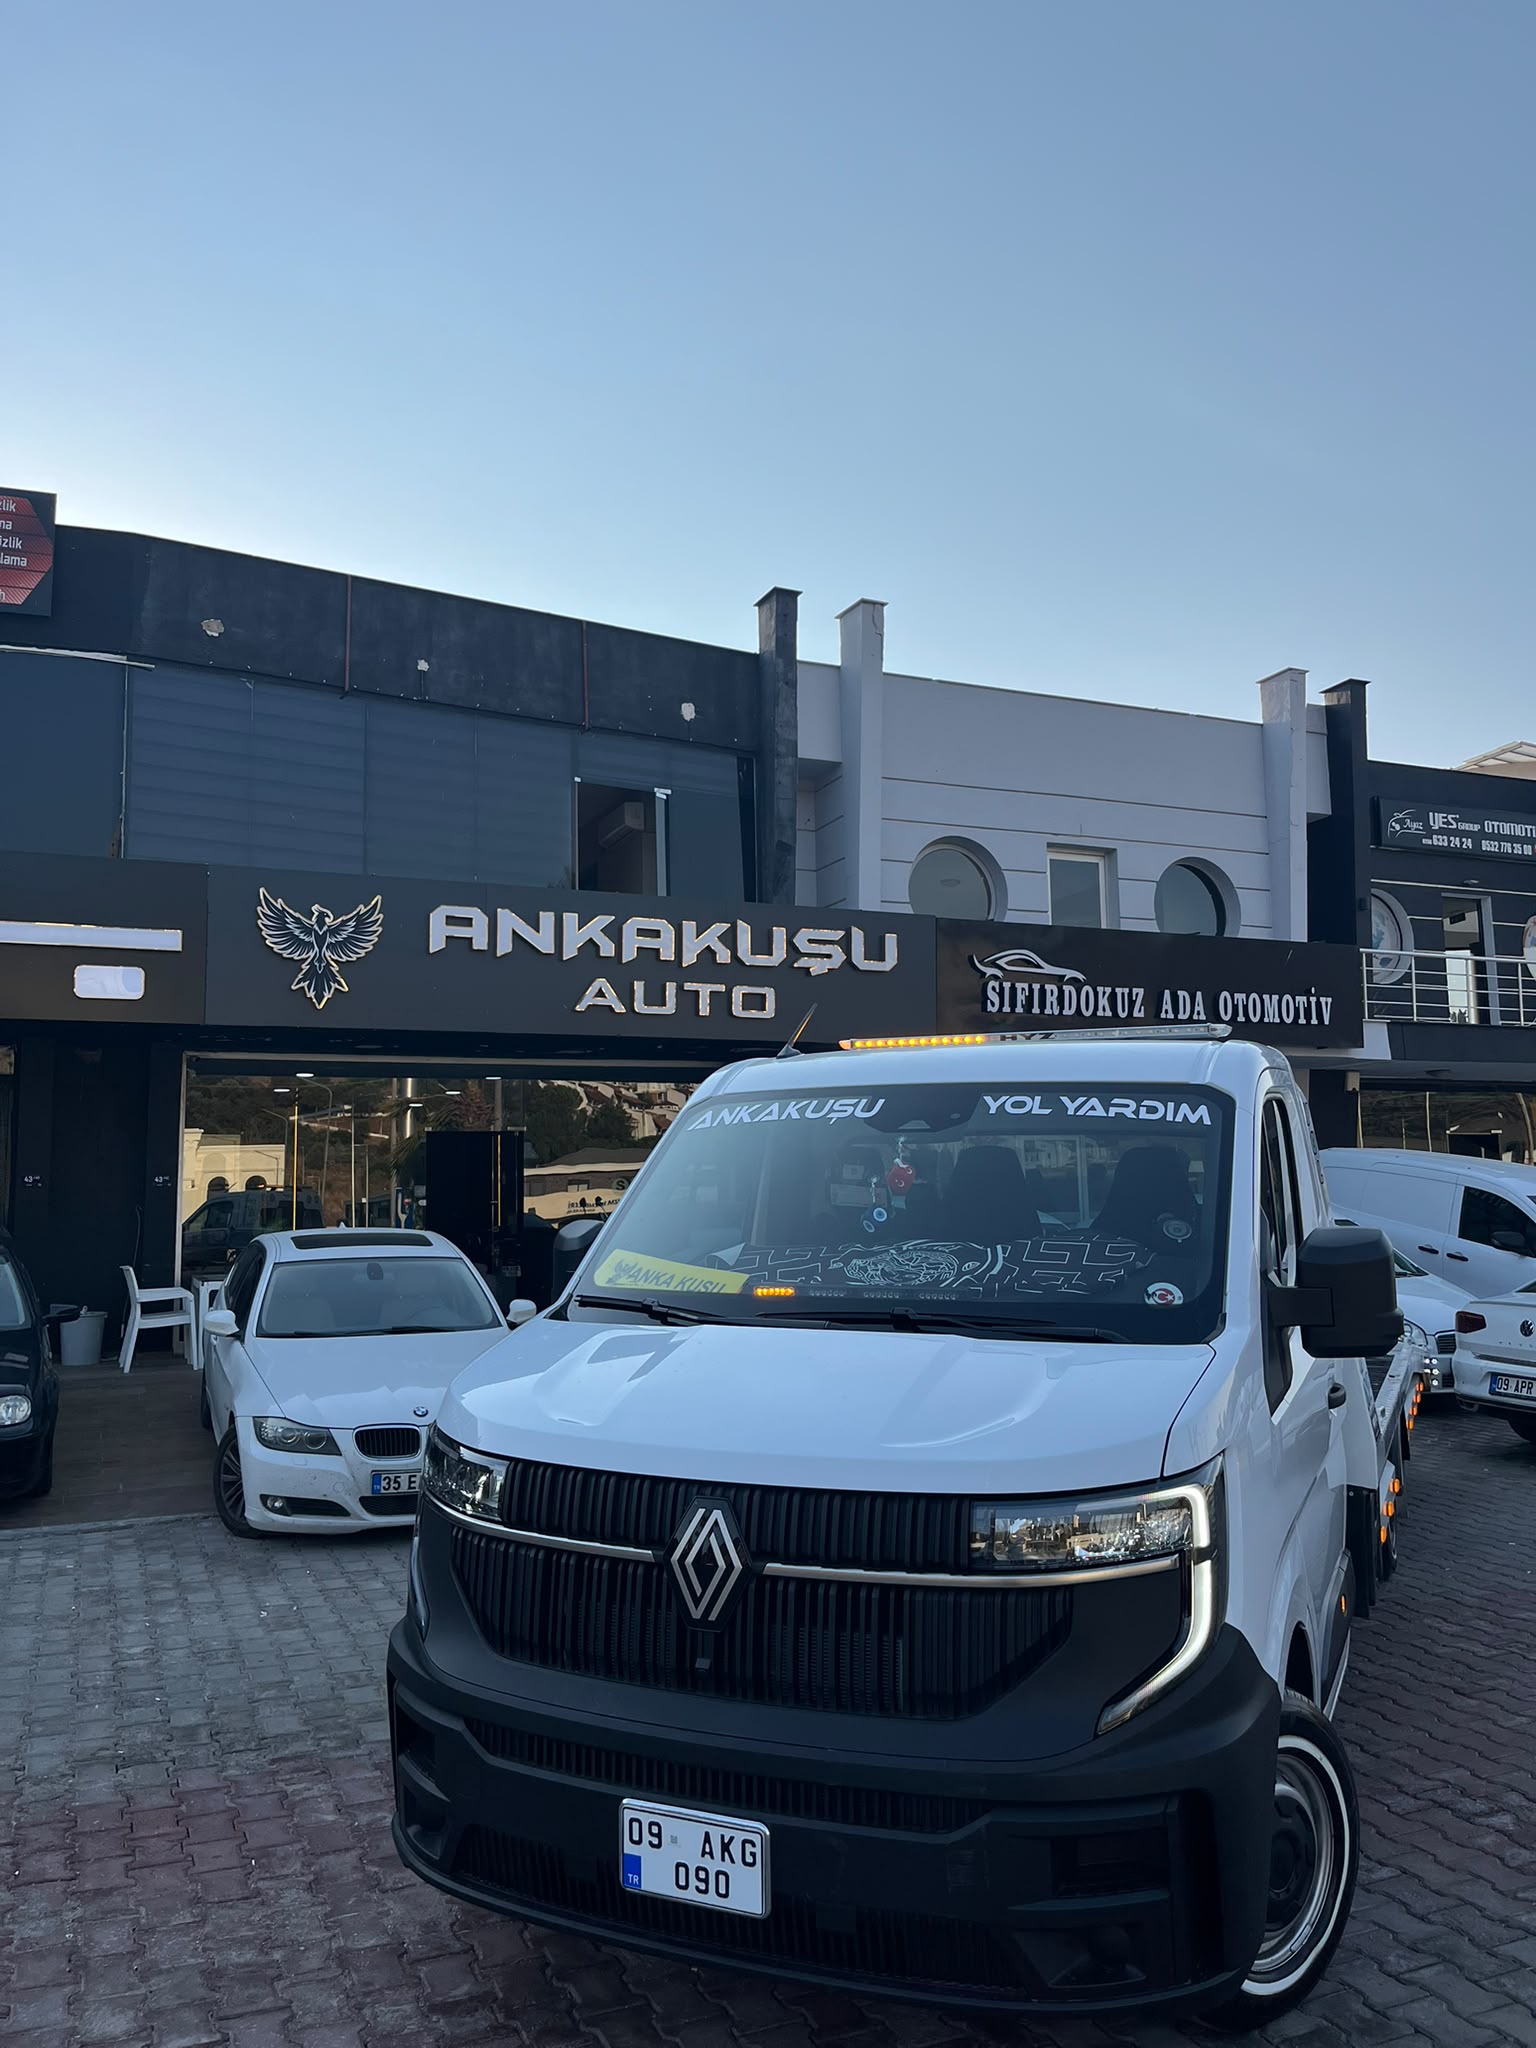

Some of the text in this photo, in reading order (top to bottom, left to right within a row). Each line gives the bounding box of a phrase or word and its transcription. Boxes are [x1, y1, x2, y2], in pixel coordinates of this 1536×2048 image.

[1449, 836, 1460, 848] 24
[1461, 837, 1472, 849] 24
[429, 904, 899, 977] ANKAKUŞU
[574, 977, 776, 1019] AUTO
[986, 980, 1333, 1025] SIFIRDOKUZ ADA OTOMOTİV
[687, 1098, 886, 1132] ANKAKUŞU
[982, 1095, 1212, 1126] YOL YARDIM
[626, 1266, 676, 1289] ANKA
[1497, 1377, 1510, 1391] 09
[1514, 1379, 1534, 1395] APR
[382, 1474, 418, 1491] 35 E
[628, 1817, 758, 1868] 09 AKG
[627, 1872, 640, 1885] TR
[674, 1861, 730, 1899] 090
